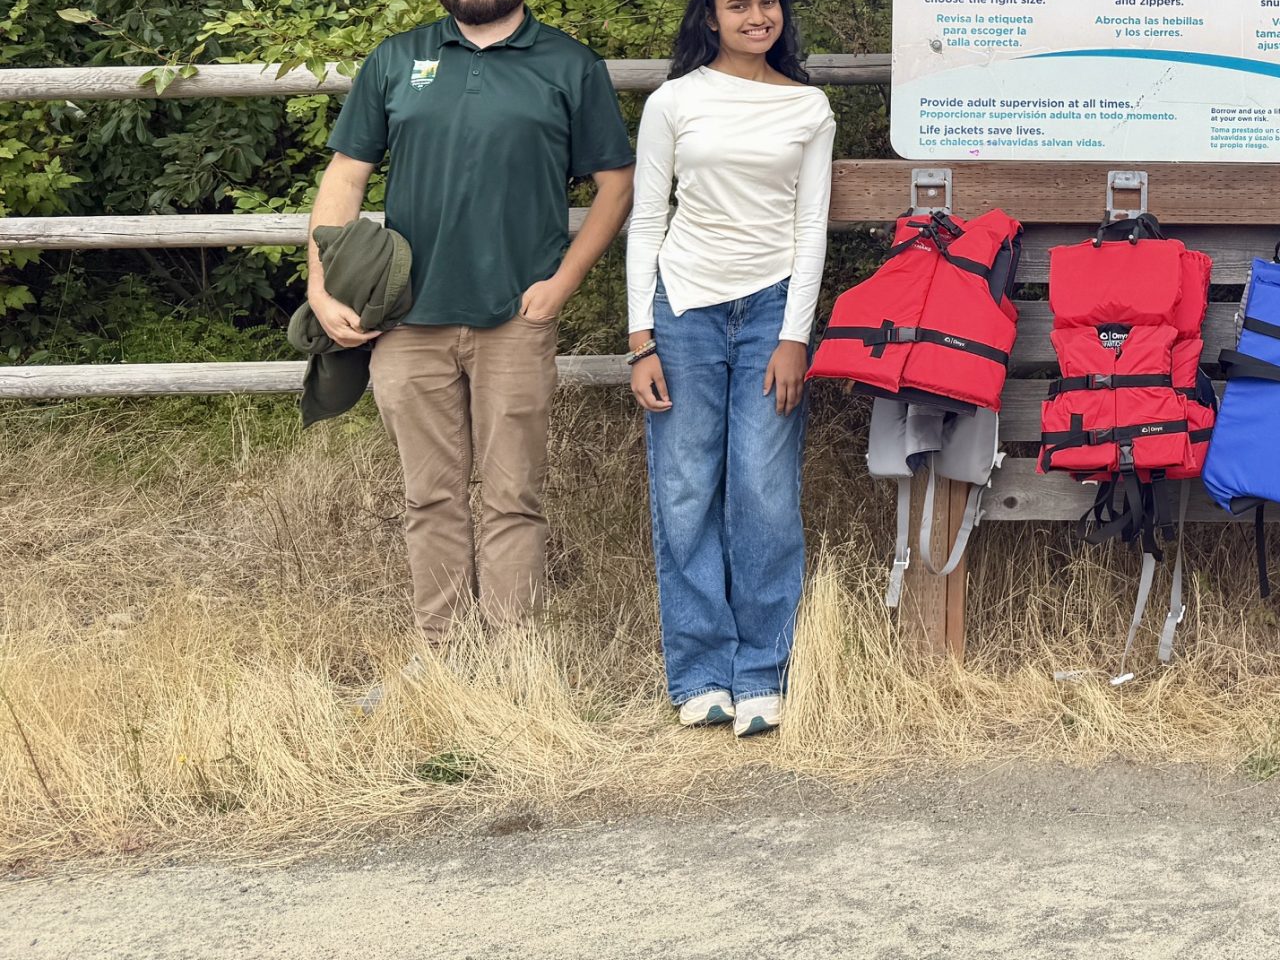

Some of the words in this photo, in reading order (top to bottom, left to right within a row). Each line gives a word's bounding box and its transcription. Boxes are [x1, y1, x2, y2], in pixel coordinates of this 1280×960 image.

[936, 14, 972, 23] Revisa
[975, 14, 984, 23] la
[988, 14, 1034, 25] etiqueta
[1095, 16, 1141, 25] Abrocha
[1144, 16, 1159, 25] las
[1162, 16, 1204, 26] hebillas
[943, 28, 967, 36] para
[970, 28, 1014, 37] escoger
[1017, 26, 1027, 35] la
[1115, 29, 1122, 38] y
[1125, 27, 1140, 36] los
[1144, 28, 1183, 37] cierres.
[946, 37, 970, 46] talla
[974, 38, 1022, 48] correcta.
[920, 98, 964, 108] Provide
[967, 98, 996, 108] adult
[1000, 98, 1064, 109] supervision
[1068, 99, 1079, 108] at
[1082, 99, 1096, 108] all
[1099, 99, 1134, 109] times.
[920, 110, 986, 120] Proporcionar
[989, 110, 1047, 120] supervisión
[1049, 110, 1081, 120] adulta
[1100, 111, 1123, 120] todo
[920, 125, 940, 134] Life
[944, 125, 984, 136] jackets
[1016, 126, 1044, 135] lives.
[919, 138, 937, 146] Los
[940, 137, 984, 146] chalecos
[986, 138, 1038, 146] salvavidas
[1041, 138, 1073, 147] salvan
[1076, 138, 1105, 147] vidas.
